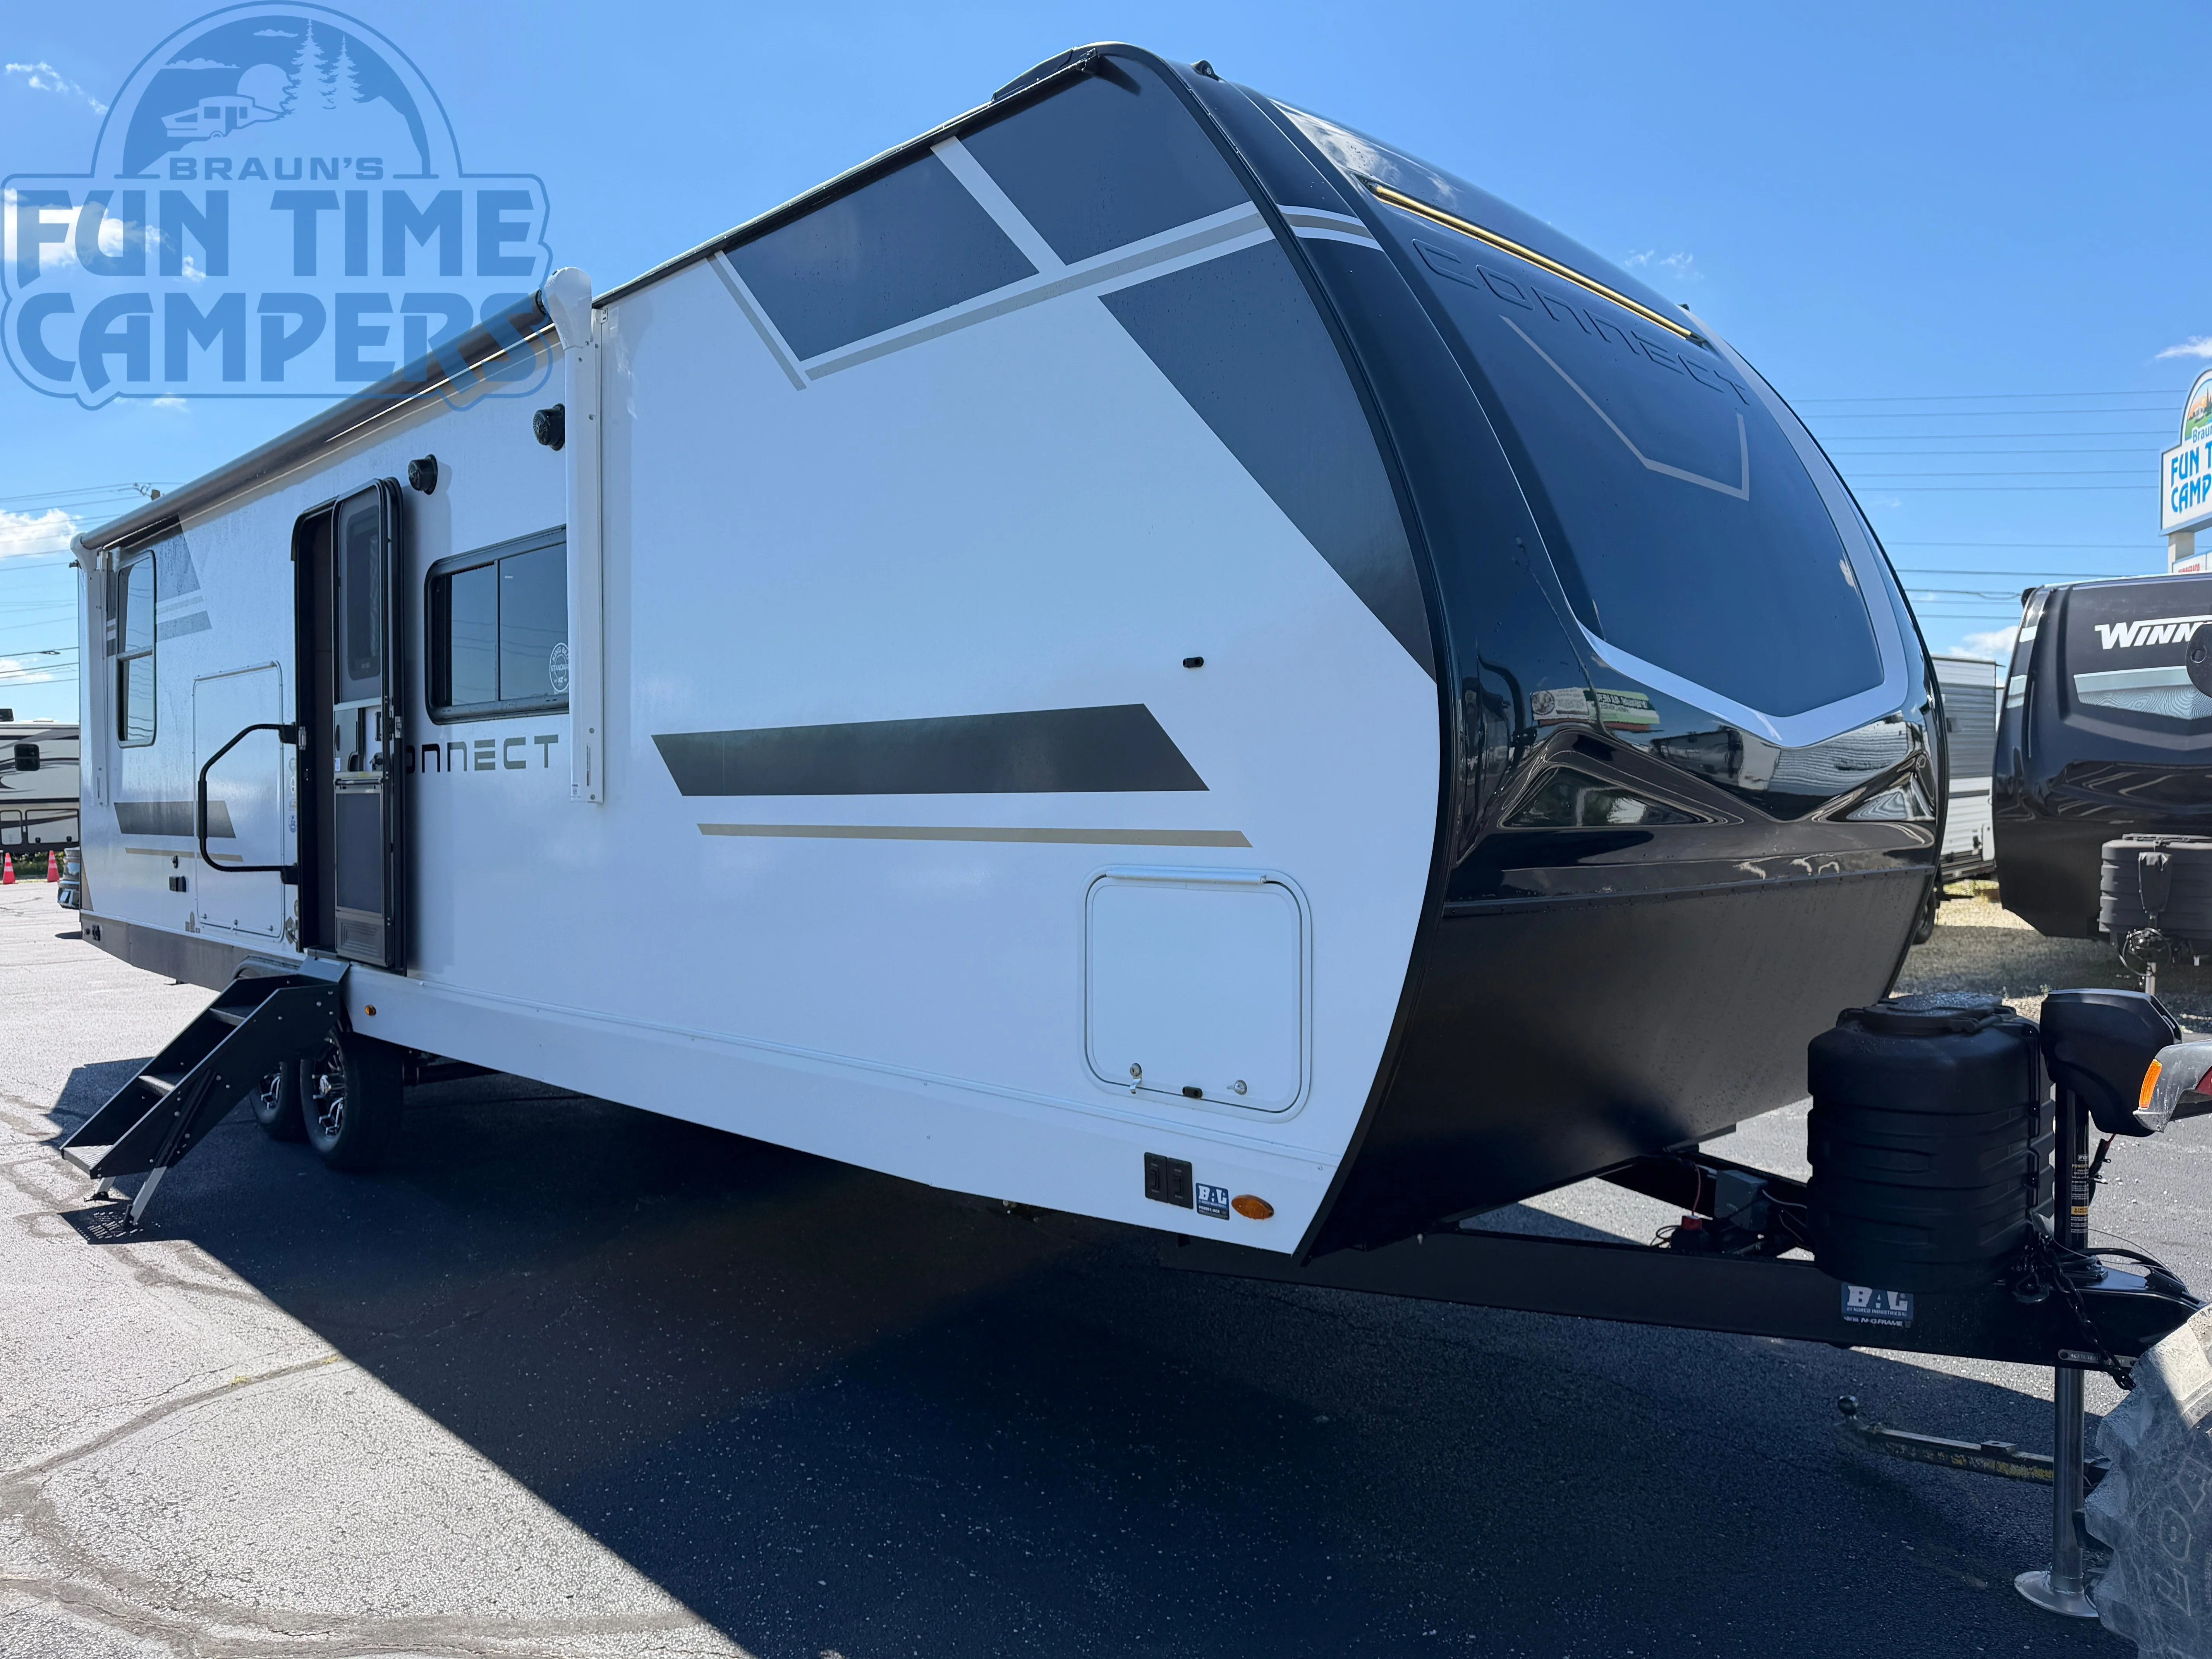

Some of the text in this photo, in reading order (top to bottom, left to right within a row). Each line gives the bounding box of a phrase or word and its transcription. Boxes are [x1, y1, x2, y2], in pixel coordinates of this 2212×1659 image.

[2171, 446, 2199, 488] FUN
[2095, 615, 2212, 649] WINN
[551, 663, 568, 672] STANDAR
[406, 734, 559, 774] NNECT
[1847, 1285, 1908, 1311] BAL
